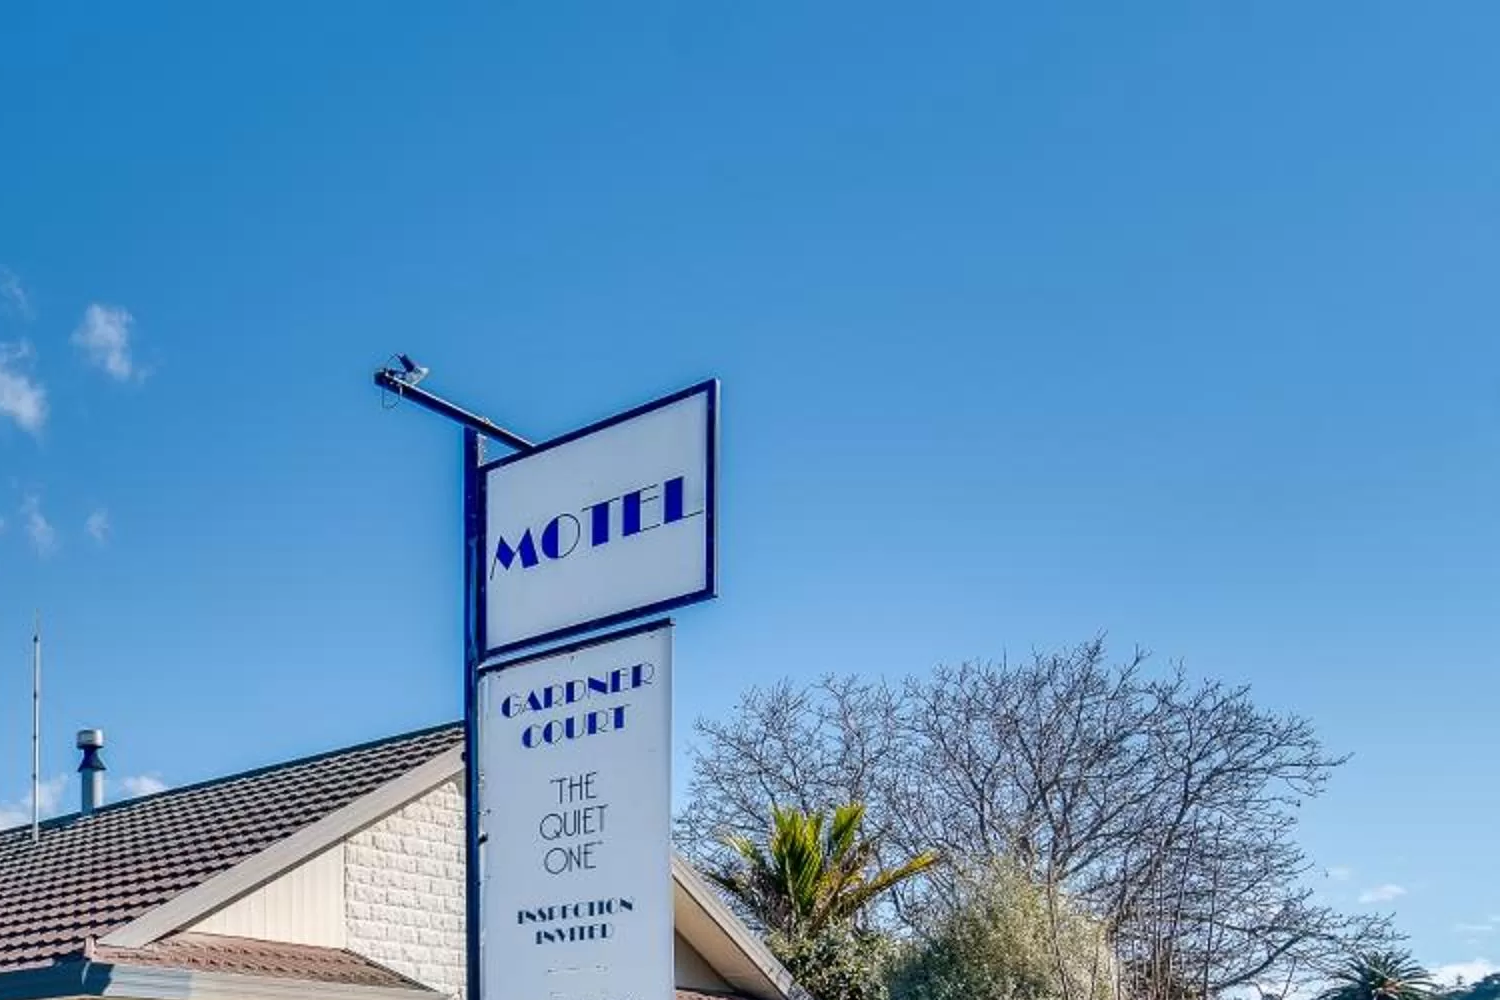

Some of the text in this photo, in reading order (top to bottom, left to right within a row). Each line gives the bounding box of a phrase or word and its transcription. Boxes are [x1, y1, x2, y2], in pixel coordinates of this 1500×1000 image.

[489, 476, 704, 580] MOTEL
[501, 662, 655, 719] GARDNER
[522, 703, 632, 748] COURT
[550, 772, 597, 804] THE
[540, 804, 608, 841] QUIET
[544, 840, 604, 875] ONE
[517, 897, 635, 924] INSPECTION
[536, 923, 613, 944] INVITED
